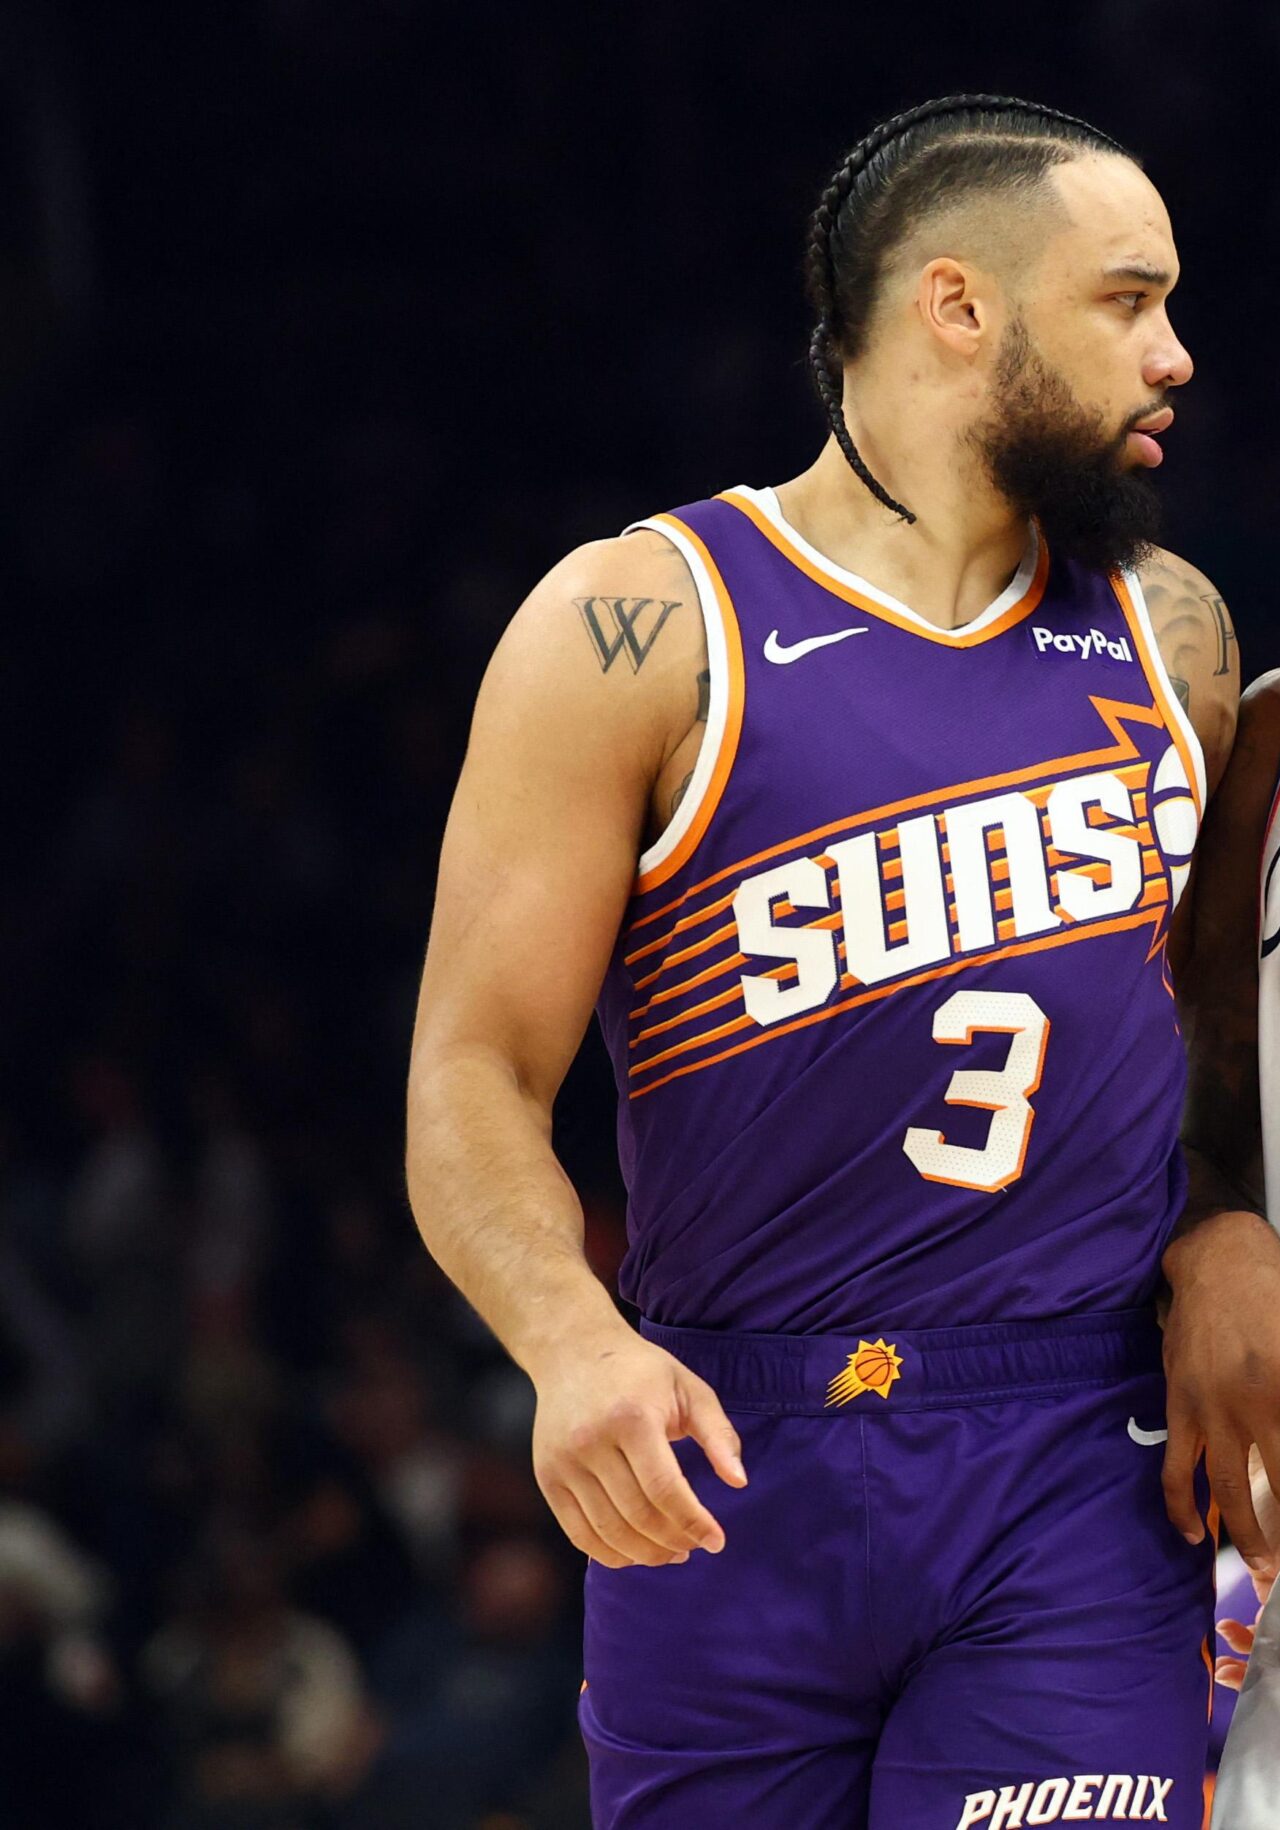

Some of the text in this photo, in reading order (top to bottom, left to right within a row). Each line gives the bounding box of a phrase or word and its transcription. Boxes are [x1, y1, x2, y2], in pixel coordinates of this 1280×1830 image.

[572, 597, 683, 676] W
[1032, 627, 1133, 662] PayPal
[731, 772, 1143, 1028] SUNS
[902, 990, 1052, 1194] 3
[955, 1773, 1175, 1830] PHOENIX
